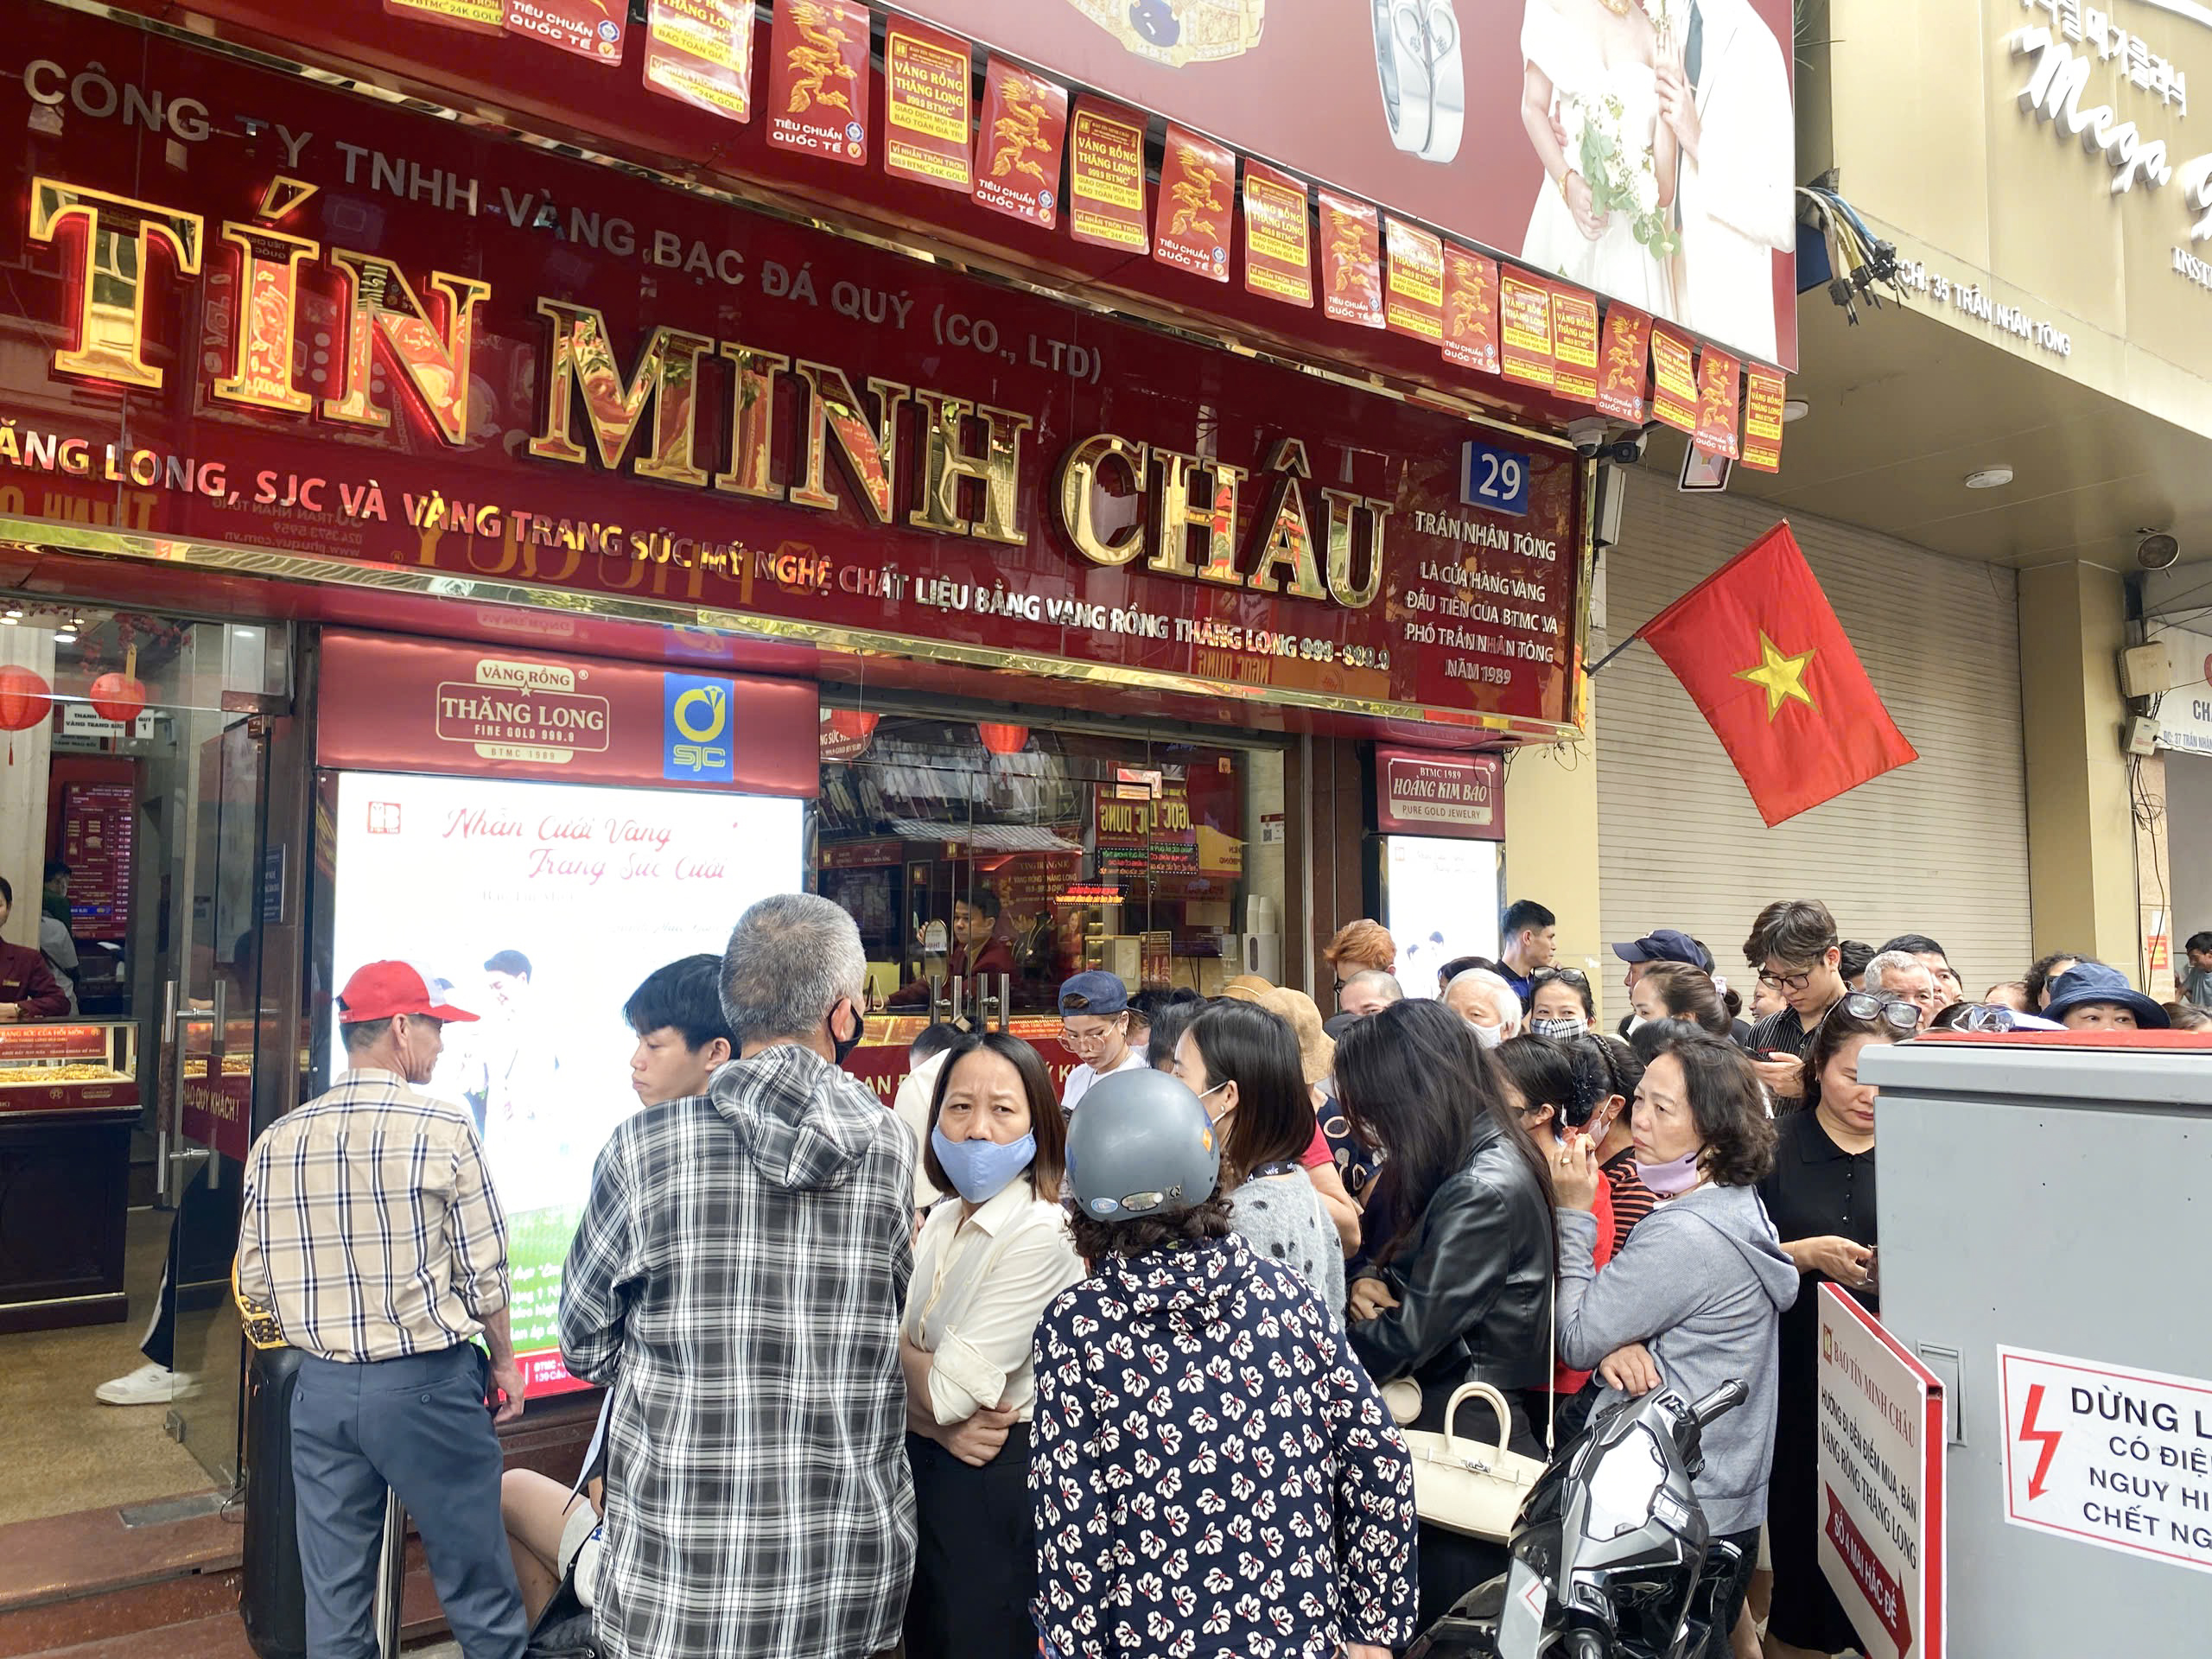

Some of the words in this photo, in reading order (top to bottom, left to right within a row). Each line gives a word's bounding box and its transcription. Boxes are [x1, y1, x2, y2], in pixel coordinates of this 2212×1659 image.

[894, 60, 928, 81] VÀNG
[931, 71, 963, 92] RỒNG
[894, 76, 933, 98] THĂNG
[935, 88, 963, 108] LONG
[895, 104, 913, 116] GIAO
[2012, 24, 2172, 194] Mega
[772, 131, 817, 148] QUỐC
[822, 141, 842, 154] TẾ
[774, 118, 801, 131] TIÊU
[802, 123, 843, 141] CHUẨN
[946, 169, 967, 182] GOLD
[976, 190, 1014, 209] QUỐC
[1018, 204, 1035, 217] TẾ
[978, 179, 1001, 194] TIÊU
[1002, 187, 1036, 206] CHUẨN
[23, 58, 210, 142] CÔNG
[335, 141, 479, 217] TNHH
[500, 189, 636, 257] VÀNG
[653, 230, 745, 285] BẠC
[761, 261, 818, 307] ĐÁ
[831, 281, 914, 330] QUÝ
[1028, 334, 1102, 384] LTD)
[1157, 248, 1191, 265] QUỐC
[1194, 259, 1210, 270] TẾ
[1160, 238, 1179, 251] TIÊU
[1179, 245, 1210, 261] CHUẨN
[1328, 296, 1344, 307] TIÊU
[1328, 305, 1355, 318] QUỐC
[1357, 310, 1370, 321] TẾ
[1932, 273, 1950, 302] 35
[1952, 283, 1993, 323] TRẦN
[1994, 302, 2032, 341] NHÂN
[2032, 319, 2072, 357] TÔNG
[1444, 340, 1460, 351] TIÊU
[1444, 348, 1470, 362] QUỐC
[1471, 357, 1484, 366] TẾ
[29, 175, 493, 446] TÍN
[528, 296, 1034, 546] MINH
[1058, 434, 1395, 609] CHÂU
[1478, 453, 1522, 501] 29
[105, 442, 240, 505] LONG,
[253, 470, 327, 512] SJC
[339, 479, 389, 522] VÀ
[402, 489, 502, 538] VÀNG
[511, 510, 624, 557] TRANG
[630, 525, 693, 569] SỨC
[699, 539, 747, 576] MỸ
[754, 549, 833, 596] NGHỆ
[839, 562, 909, 601] CHẤT
[915, 570, 969, 614] LIỆU
[974, 577, 1040, 621] BẰNG
[1046, 592, 1109, 631] VÀNG
[1109, 601, 1169, 639] RỒNG
[1175, 616, 1243, 651] THĂNG
[1245, 628, 1297, 658] LONG
[1414, 509, 1461, 541] TRẦN
[1463, 522, 1510, 551] NHÂN
[1513, 531, 1556, 562] TÔNG
[1420, 560, 1440, 581] LÀ
[1440, 562, 1468, 588] CỬA
[1471, 569, 1510, 596] HÀNG
[1405, 587, 1435, 613] ĐẦU
[1440, 595, 1470, 619] TIÊN
[1470, 600, 1499, 624] CỦA
[1501, 608, 1540, 632] BTMC
[1404, 621, 1436, 644] PHỐ
[1438, 625, 1475, 651] TRẦN
[1476, 634, 1515, 657] NHÂN
[1516, 639, 1554, 664] TÔNG
[481, 665, 524, 682] VÀNG
[529, 666, 571, 686] RỒNG
[1444, 658, 1479, 682] NĂM
[1480, 665, 1512, 685] 1989
[441, 695, 531, 724] THĂNG
[538, 705, 605, 731] LONG
[2193, 699, 2212, 724] CH
[474, 723, 501, 737] FINE
[506, 725, 537, 740] GOLD
[542, 727, 575, 743] 999.9
[2175, 732, 2183, 745] 37
[491, 747, 520, 758] BTMC
[529, 749, 556, 761] 1989
[1393, 775, 1436, 798] HOÀNG
[1437, 783, 1460, 802] KIM
[1463, 781, 1487, 803] BẢO
[1420, 766, 1442, 779] BTMC
[1444, 769, 1461, 780] 1989
[1402, 804, 1422, 815] PURE
[1424, 806, 1446, 817] GOLD
[1447, 807, 1480, 820] JEWELRY
[529, 848, 607, 886] Trang
[1834, 1341, 1849, 1374] BẢO
[1850, 1357, 1862, 1389] TÍN
[1864, 1374, 1888, 1418] MINH
[1889, 1402, 1916, 1448] CHÂU
[2071, 1383, 2179, 1434] DỪNG
[1821, 1385, 1842, 1427] HƯỚNG
[1842, 1412, 1849, 1436] ĐI
[1849, 1417, 1862, 1454] ĐẾN
[1863, 1438, 1880, 1477] ĐIỂM
[1881, 1465, 1900, 1505] MUA,
[1901, 1485, 1916, 1523] BÁN
[2109, 1436, 2151, 1462] CÓ
[2160, 1446, 2212, 1478] ĐIỆ
[1821, 1422, 1840, 1465] VÀNG
[1841, 1446, 1860, 1493] RỒNG
[1862, 1477, 1891, 1534] THĂNG
[1892, 1516, 1916, 1570] LONG
[2089, 1466, 2170, 1502] NGUY
[2083, 1501, 2160, 1536] CHẾT
[1834, 1510, 1845, 1543] SỐ
[1845, 1533, 1850, 1550] 4
[1851, 1538, 1864, 1578] MAI
[1865, 1559, 1884, 1605] HẮC
[1885, 1586, 1897, 1629] ĐẾ
